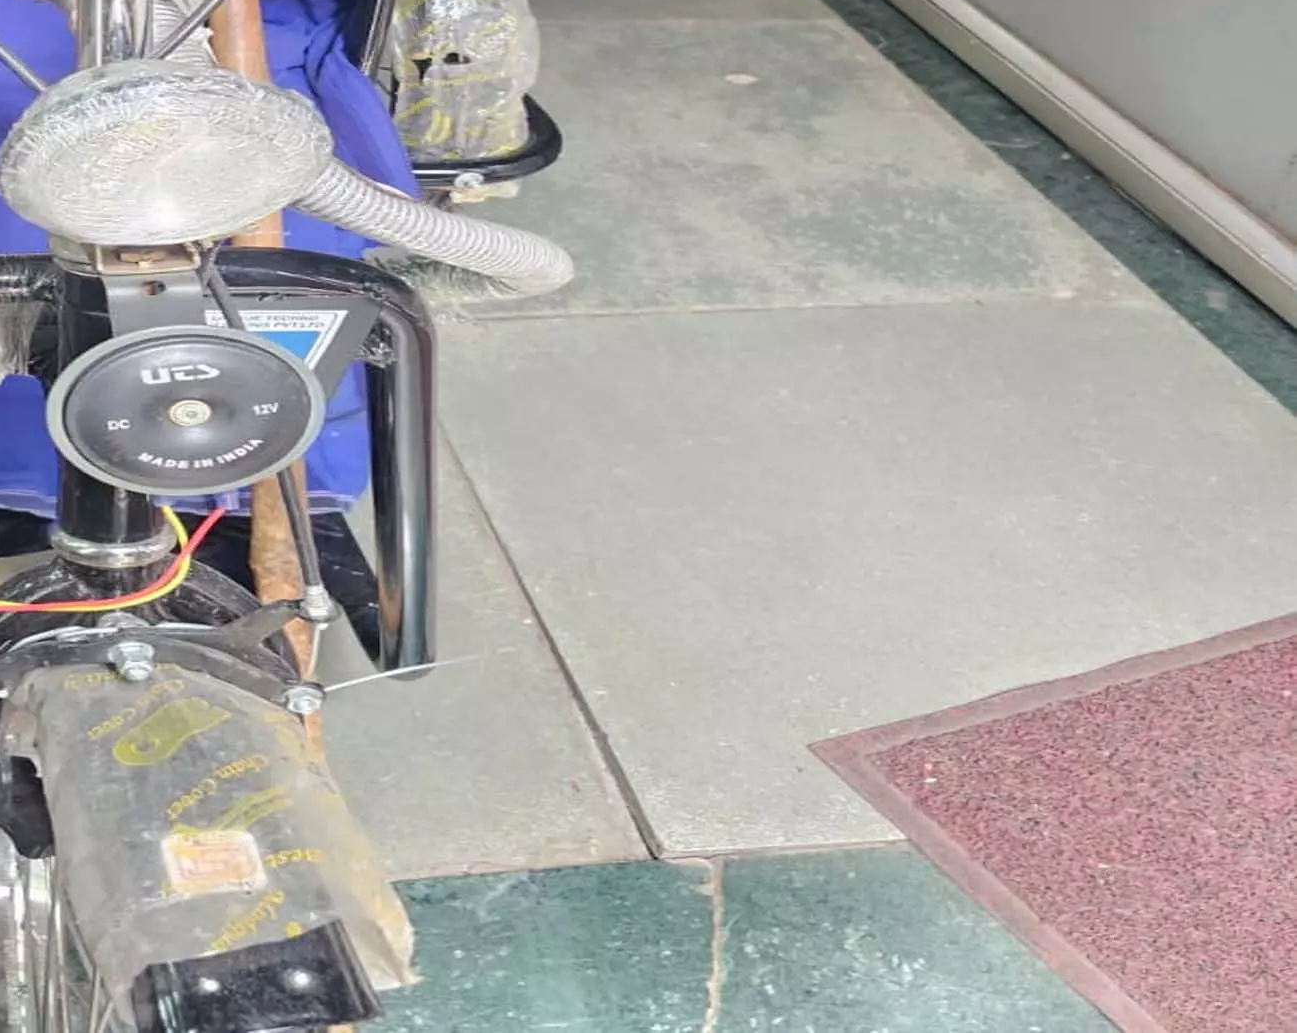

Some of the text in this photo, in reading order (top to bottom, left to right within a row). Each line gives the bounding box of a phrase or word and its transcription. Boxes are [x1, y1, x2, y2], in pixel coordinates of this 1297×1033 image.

[252, 402, 279, 415] 12V
[107, 419, 131, 430] DC
[138, 438, 264, 469] MADE IN INDIA
